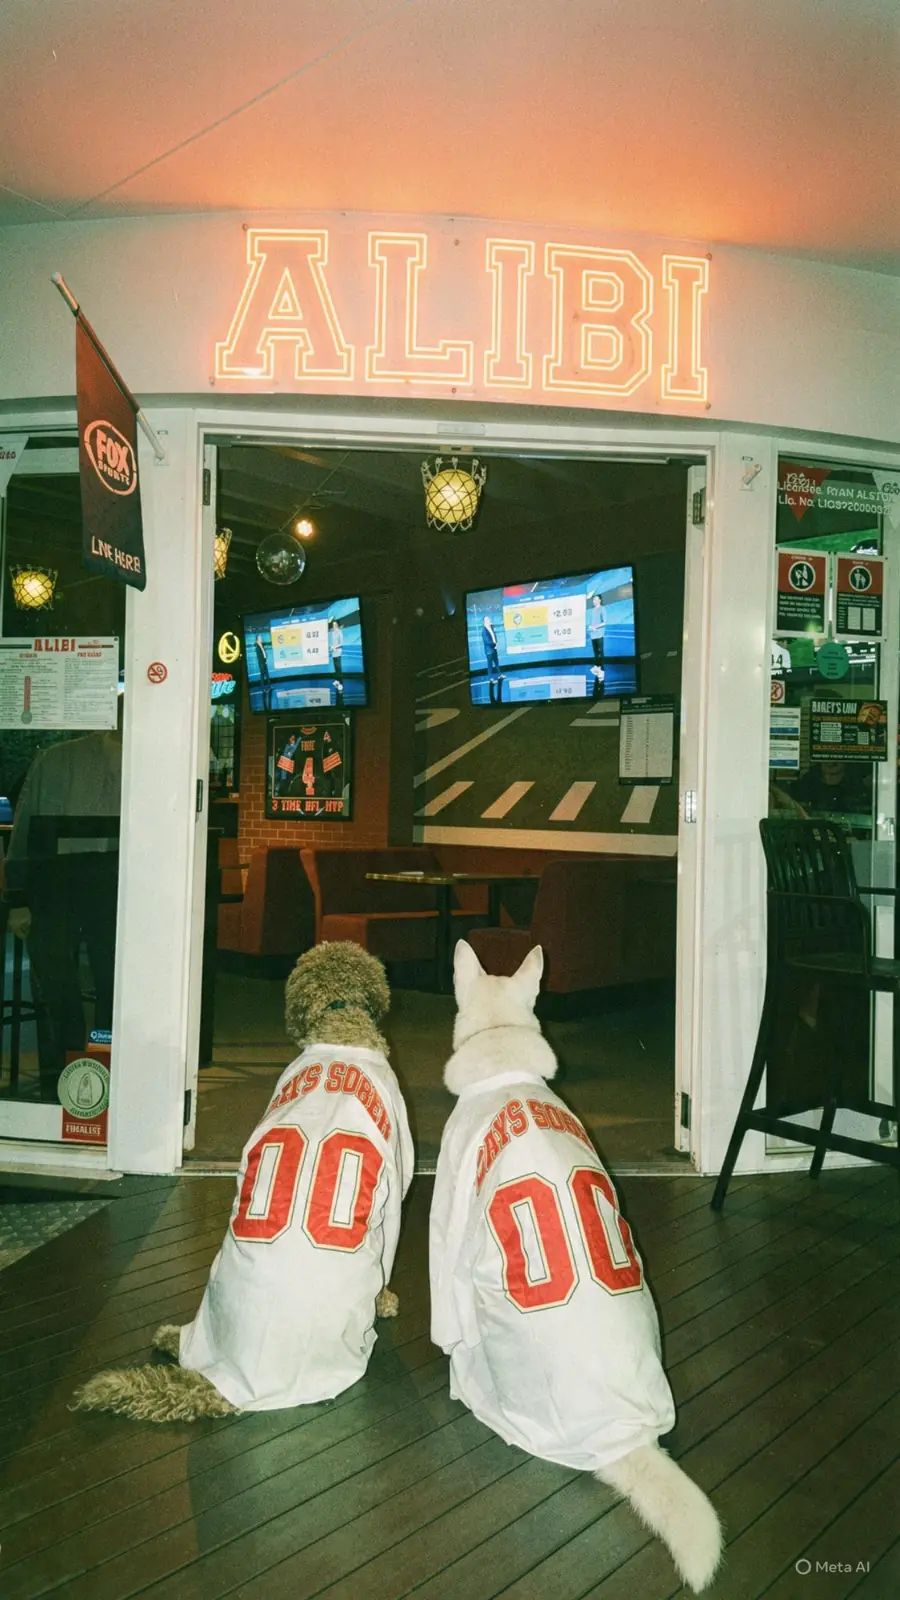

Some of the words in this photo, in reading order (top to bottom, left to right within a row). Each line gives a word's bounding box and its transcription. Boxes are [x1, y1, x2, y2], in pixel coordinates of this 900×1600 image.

[216, 228, 709, 402] ALIBI
[96, 428, 130, 477] FOX
[98, 460, 130, 486] SPORTS
[827, 486, 855, 498] RYAN
[34, 639, 76, 652] ALIBI
[302, 757, 316, 797] 4
[272, 800, 279, 812] 3
[281, 799, 302, 812] TIME
[325, 801, 344, 813] MVP
[324, 1060, 392, 1143] SOBER
[65, 1123, 102, 1137] FINALIST
[526, 1099, 597, 1156] SOB
[231, 1123, 384, 1254] 00
[485, 1165, 643, 1314] 00
